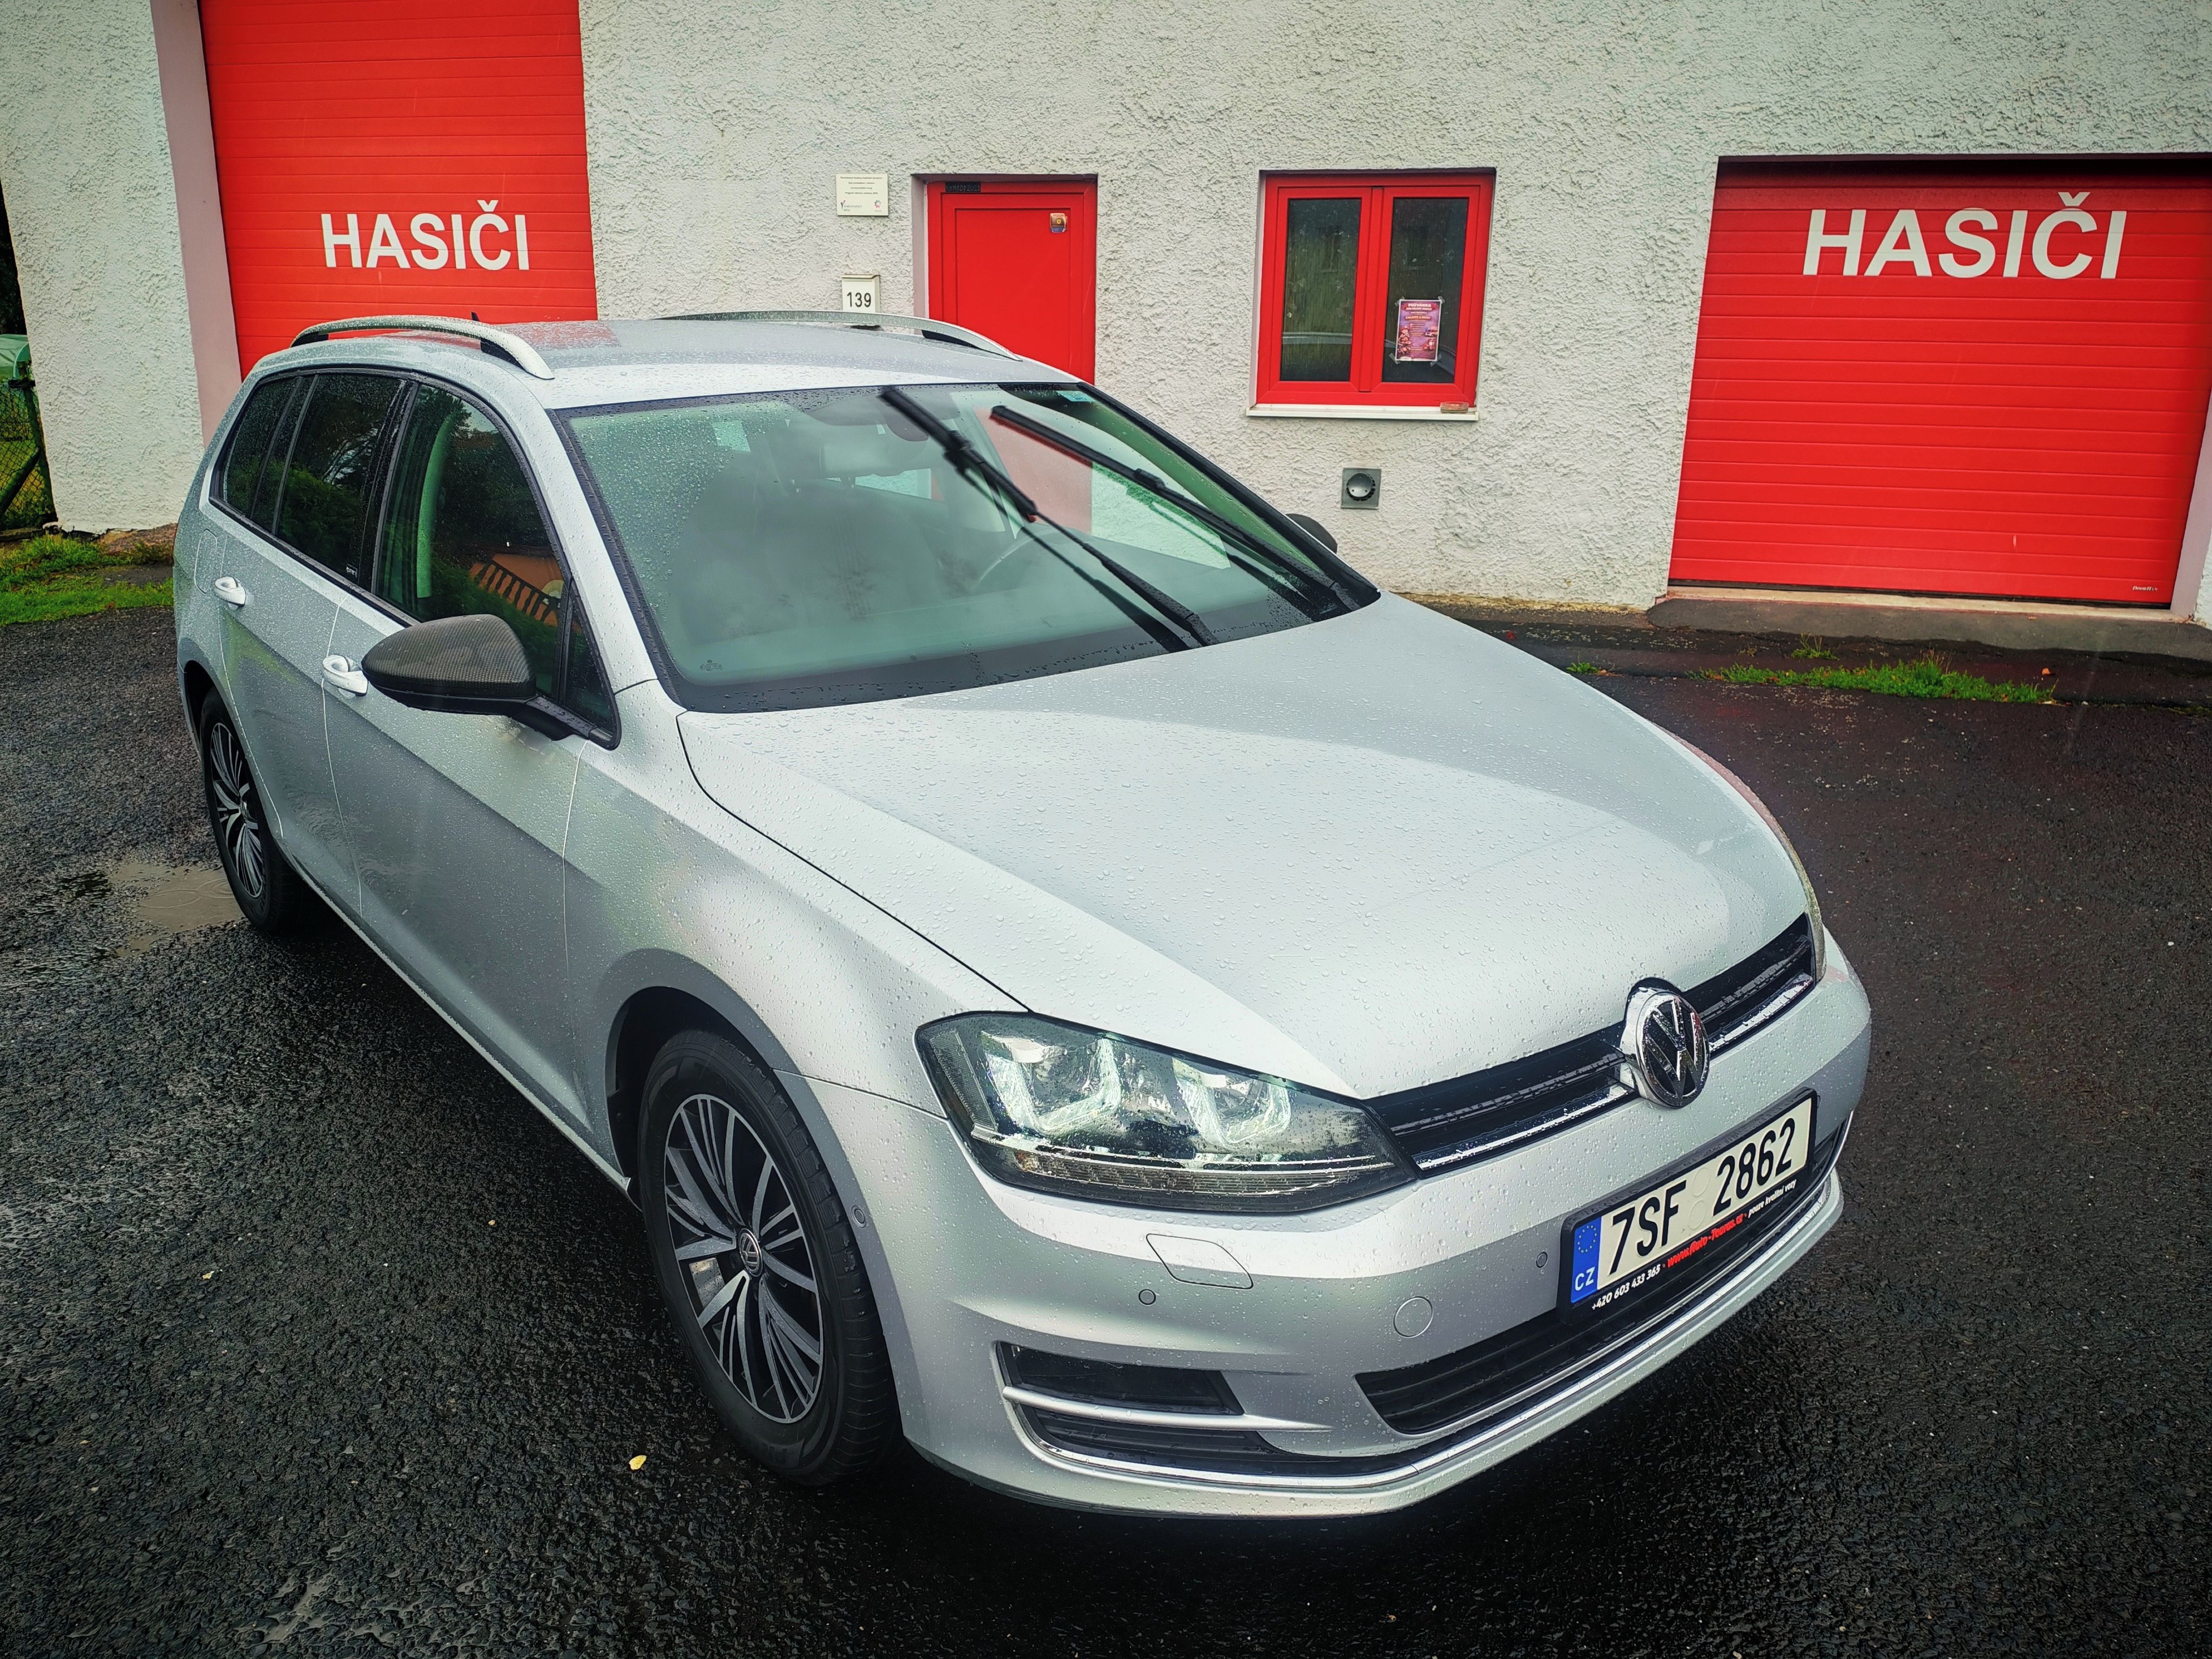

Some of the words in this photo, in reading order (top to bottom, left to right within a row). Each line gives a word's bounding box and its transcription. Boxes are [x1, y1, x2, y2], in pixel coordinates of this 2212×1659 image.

[321, 199, 530, 271] HASIČI
[1803, 192, 2127, 279] HASIČI
[847, 292, 871, 307] 139
[1609, 1179, 1687, 1276] 7SF
[1712, 1118, 1796, 1217] 2862
[1575, 1266, 1596, 1291] CZ
[1591, 1292, 1613, 1310] +420
[1614, 1282, 1630, 1299] 603
[1631, 1273, 1645, 1288] 433
[1646, 1264, 1661, 1280] 365
[1748, 1201, 1764, 1218] pouze
